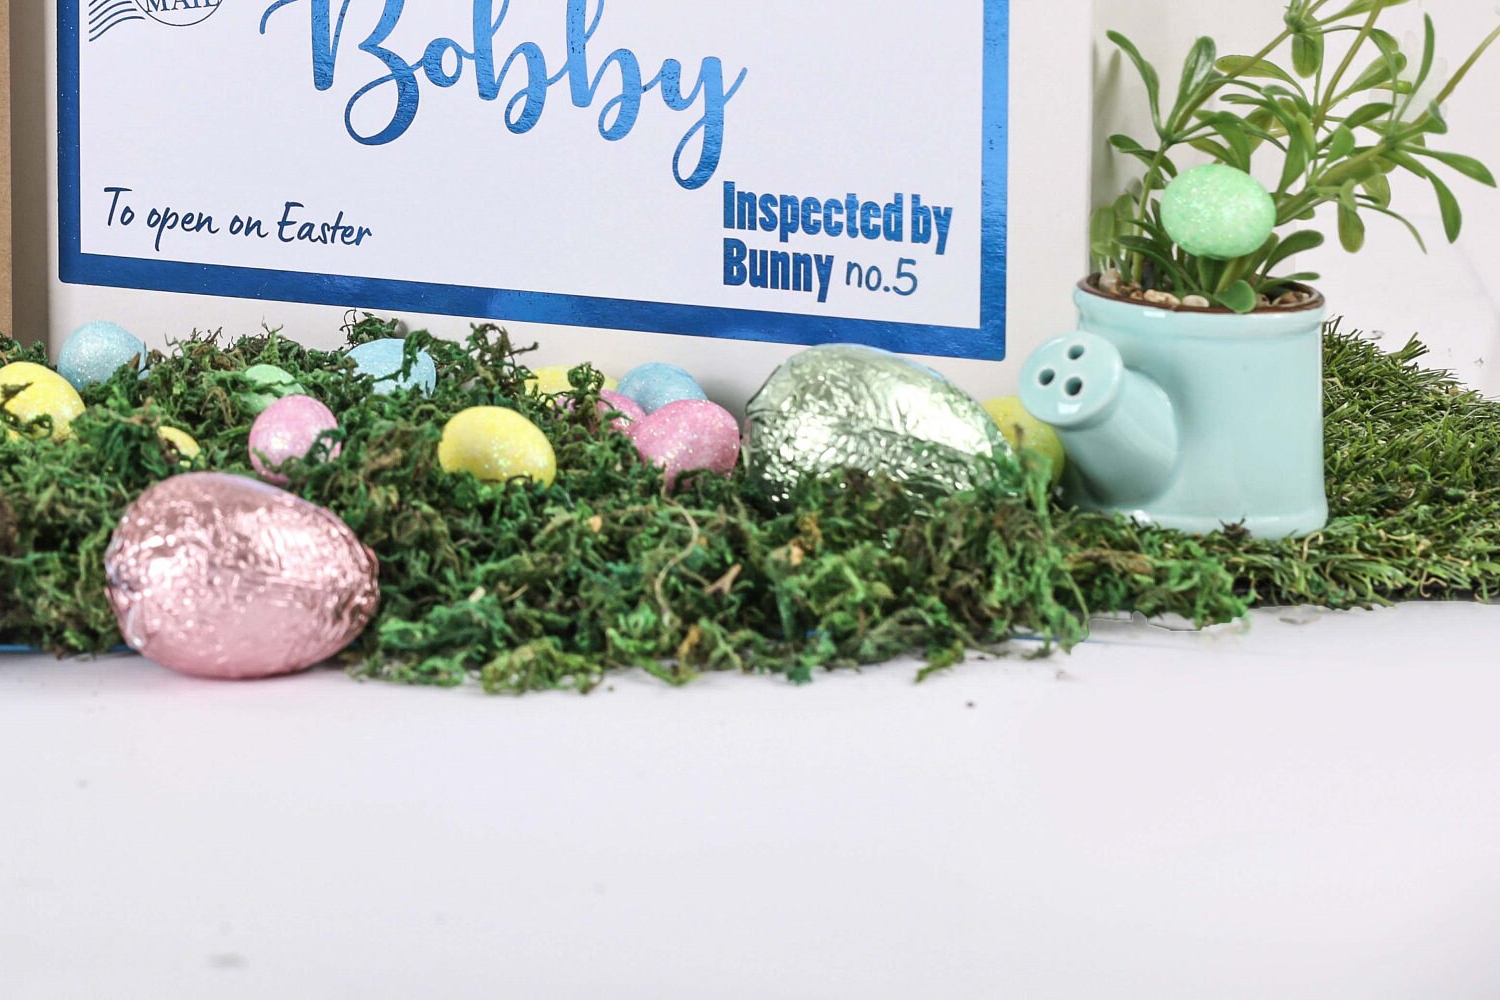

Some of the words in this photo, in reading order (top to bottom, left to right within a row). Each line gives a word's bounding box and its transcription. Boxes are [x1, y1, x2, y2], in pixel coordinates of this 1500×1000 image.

[104, 187, 135, 226] To
[147, 207, 220, 252] open
[229, 215, 269, 238] on
[277, 201, 372, 246] Easter
[723, 181, 904, 243] Inspected
[911, 194, 953, 255] by
[723, 237, 834, 303] Bunny
[846, 257, 918, 296] no.5
